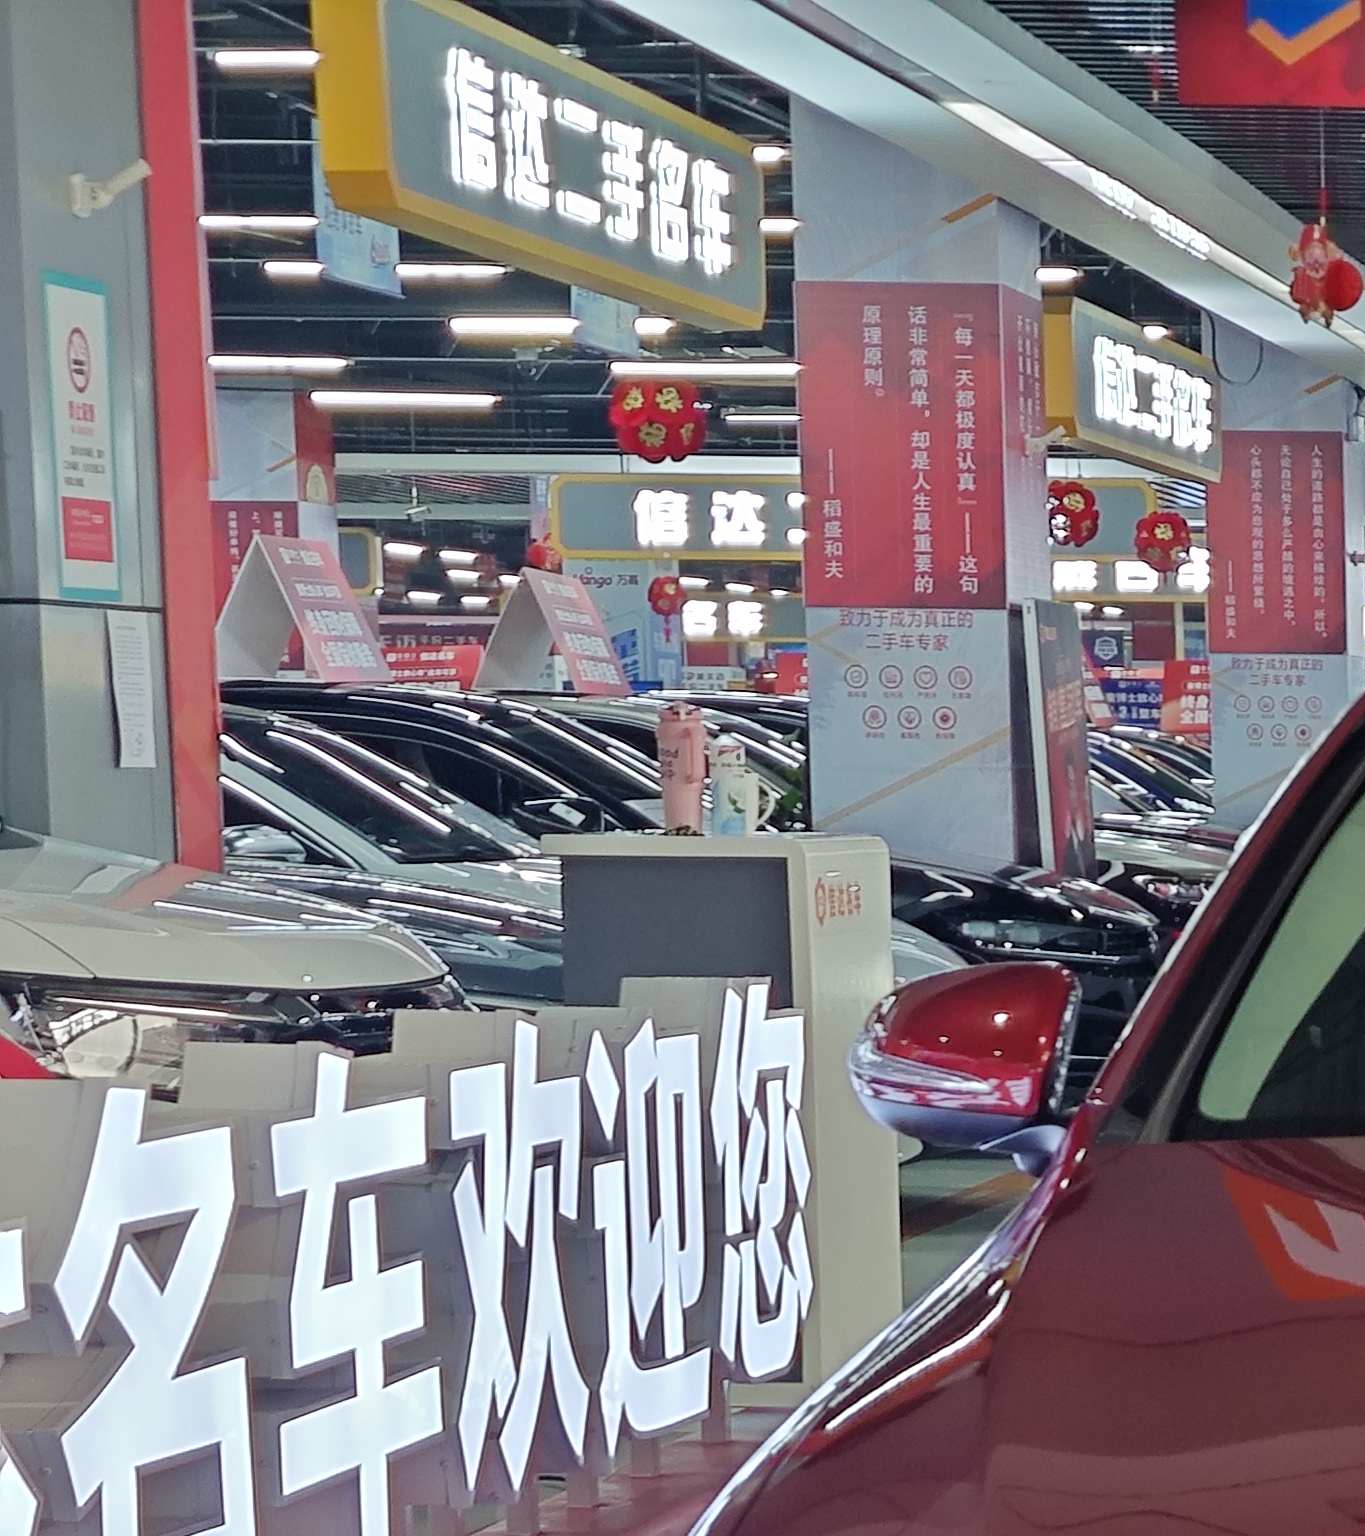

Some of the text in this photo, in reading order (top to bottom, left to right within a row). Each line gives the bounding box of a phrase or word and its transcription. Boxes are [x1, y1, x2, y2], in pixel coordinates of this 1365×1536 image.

[446, 47, 733, 275] 信达二手名车
[839, 609, 974, 628] 致力于成为真正的
[866, 633, 950, 652] 二手车专家
